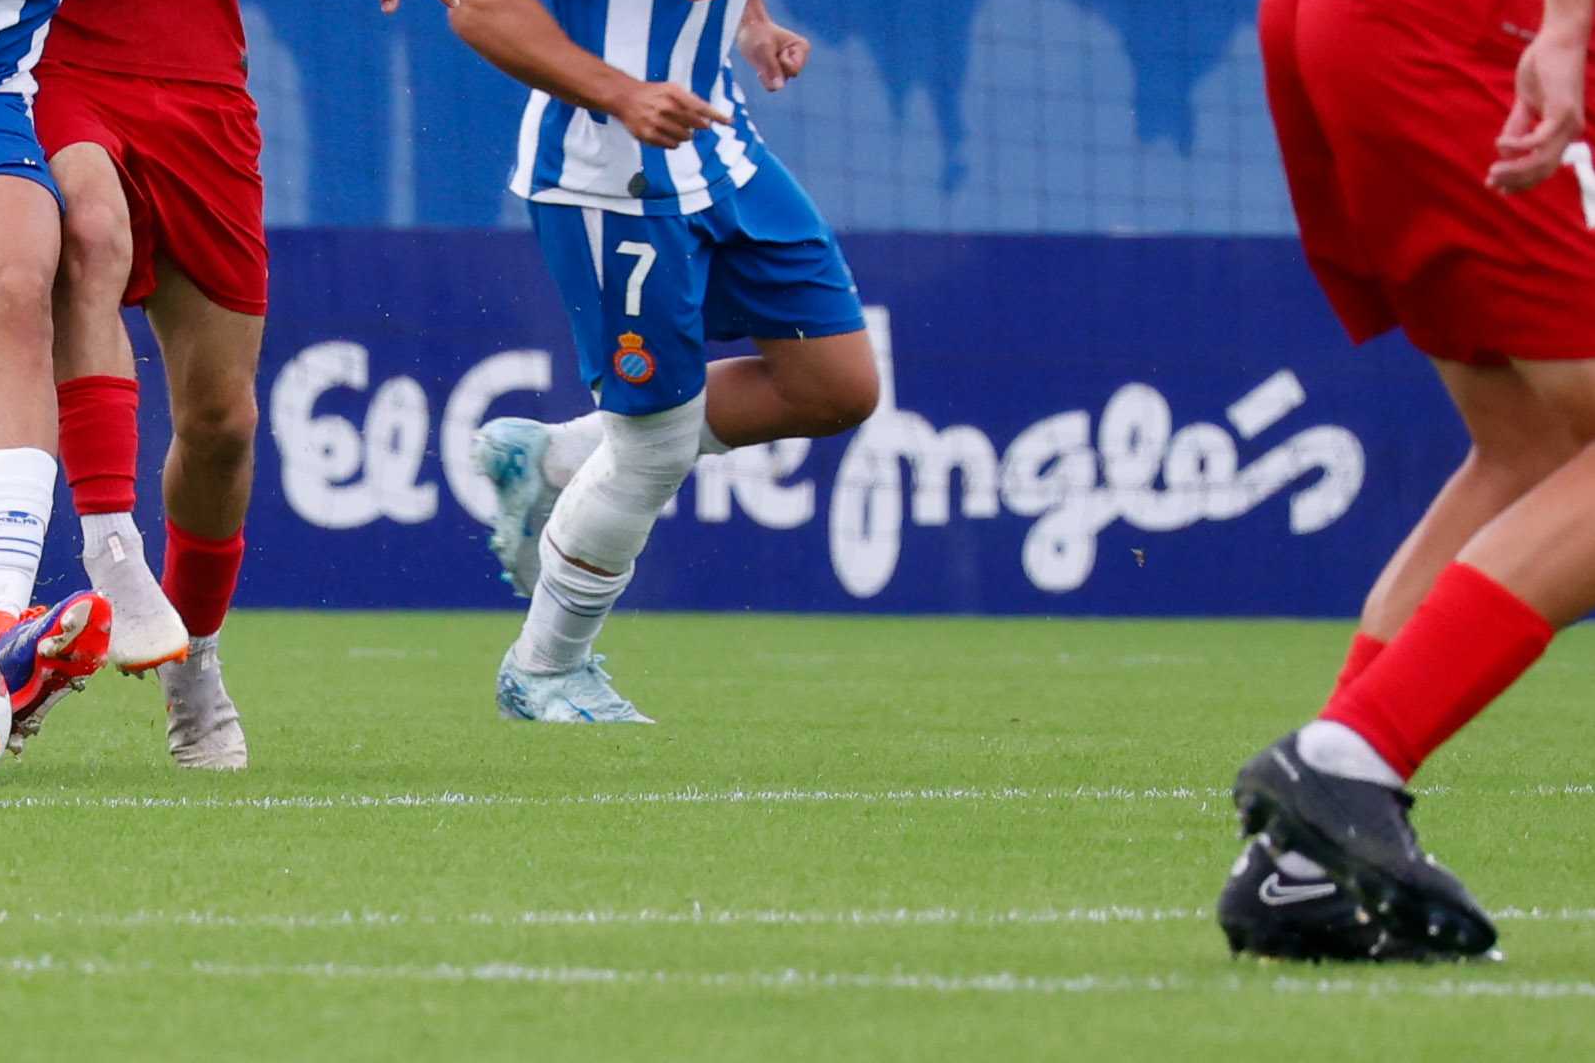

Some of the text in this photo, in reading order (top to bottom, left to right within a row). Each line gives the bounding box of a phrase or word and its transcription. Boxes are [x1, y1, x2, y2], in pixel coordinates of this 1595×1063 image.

[615, 239, 657, 317] 7
[269, 339, 440, 530] El
[828, 304, 1366, 599] Inglés
